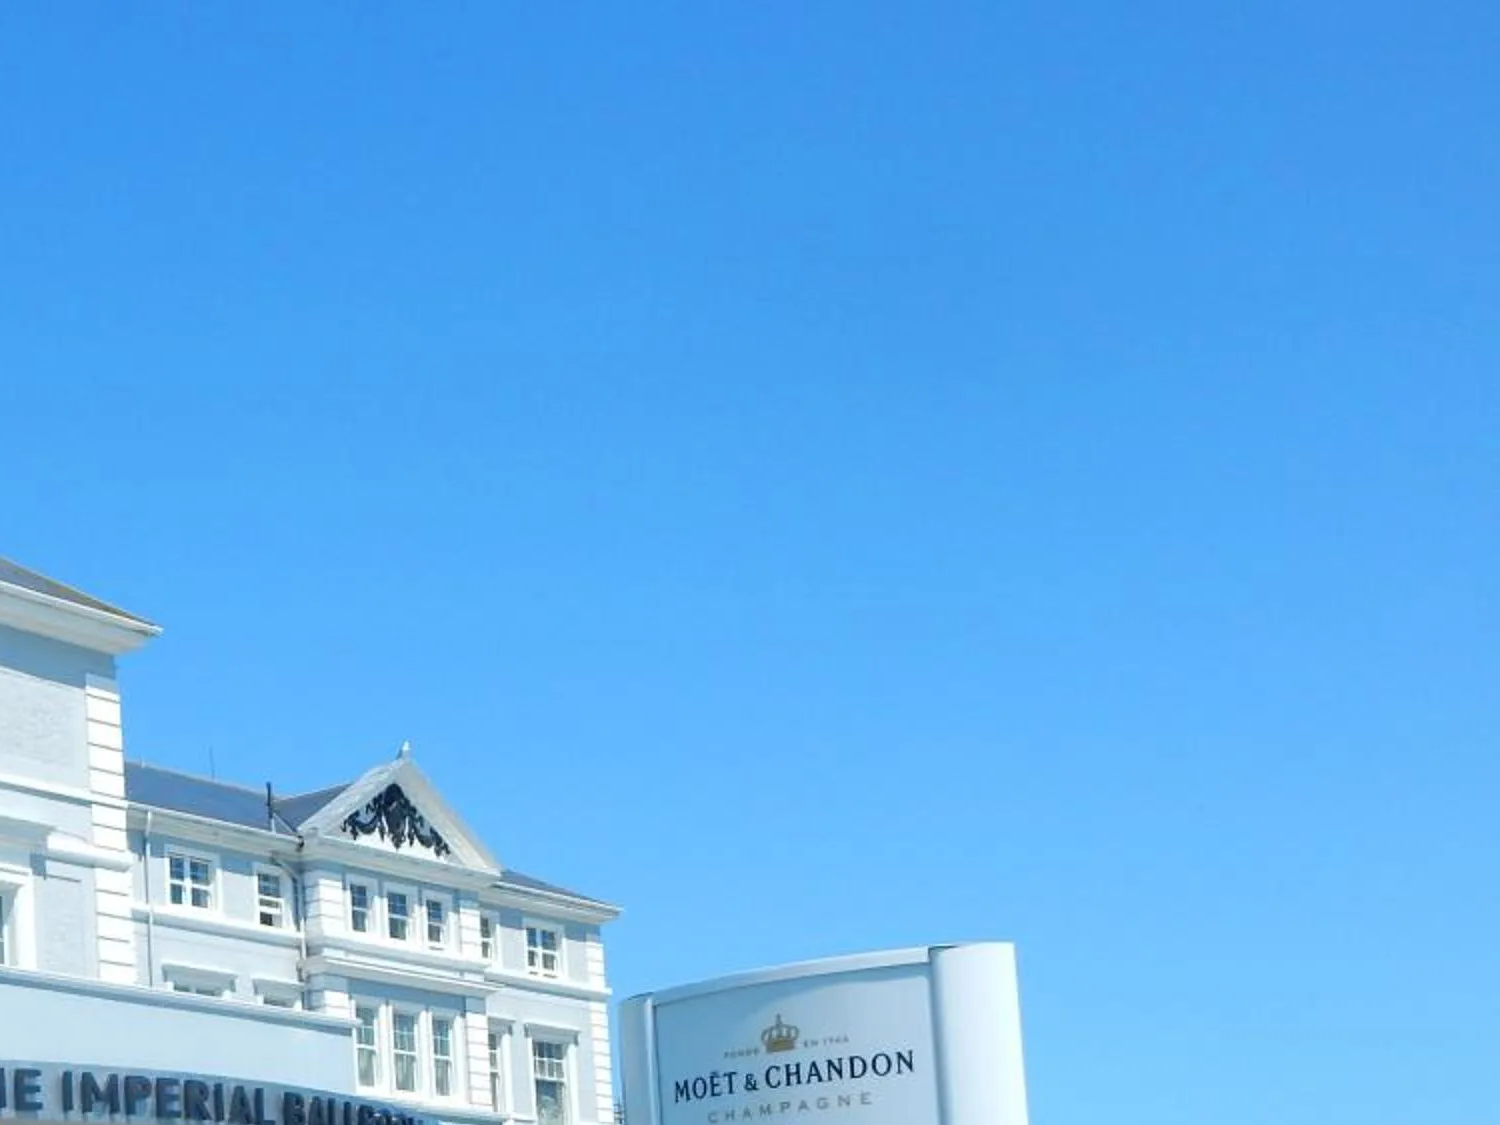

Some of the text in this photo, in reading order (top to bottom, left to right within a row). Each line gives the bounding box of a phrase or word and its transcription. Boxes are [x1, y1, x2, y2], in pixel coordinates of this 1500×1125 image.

[744, 1073, 759, 1091] &
[765, 1050, 914, 1089] CHANDON
[708, 1091, 873, 1124] CHAMPAGNE
